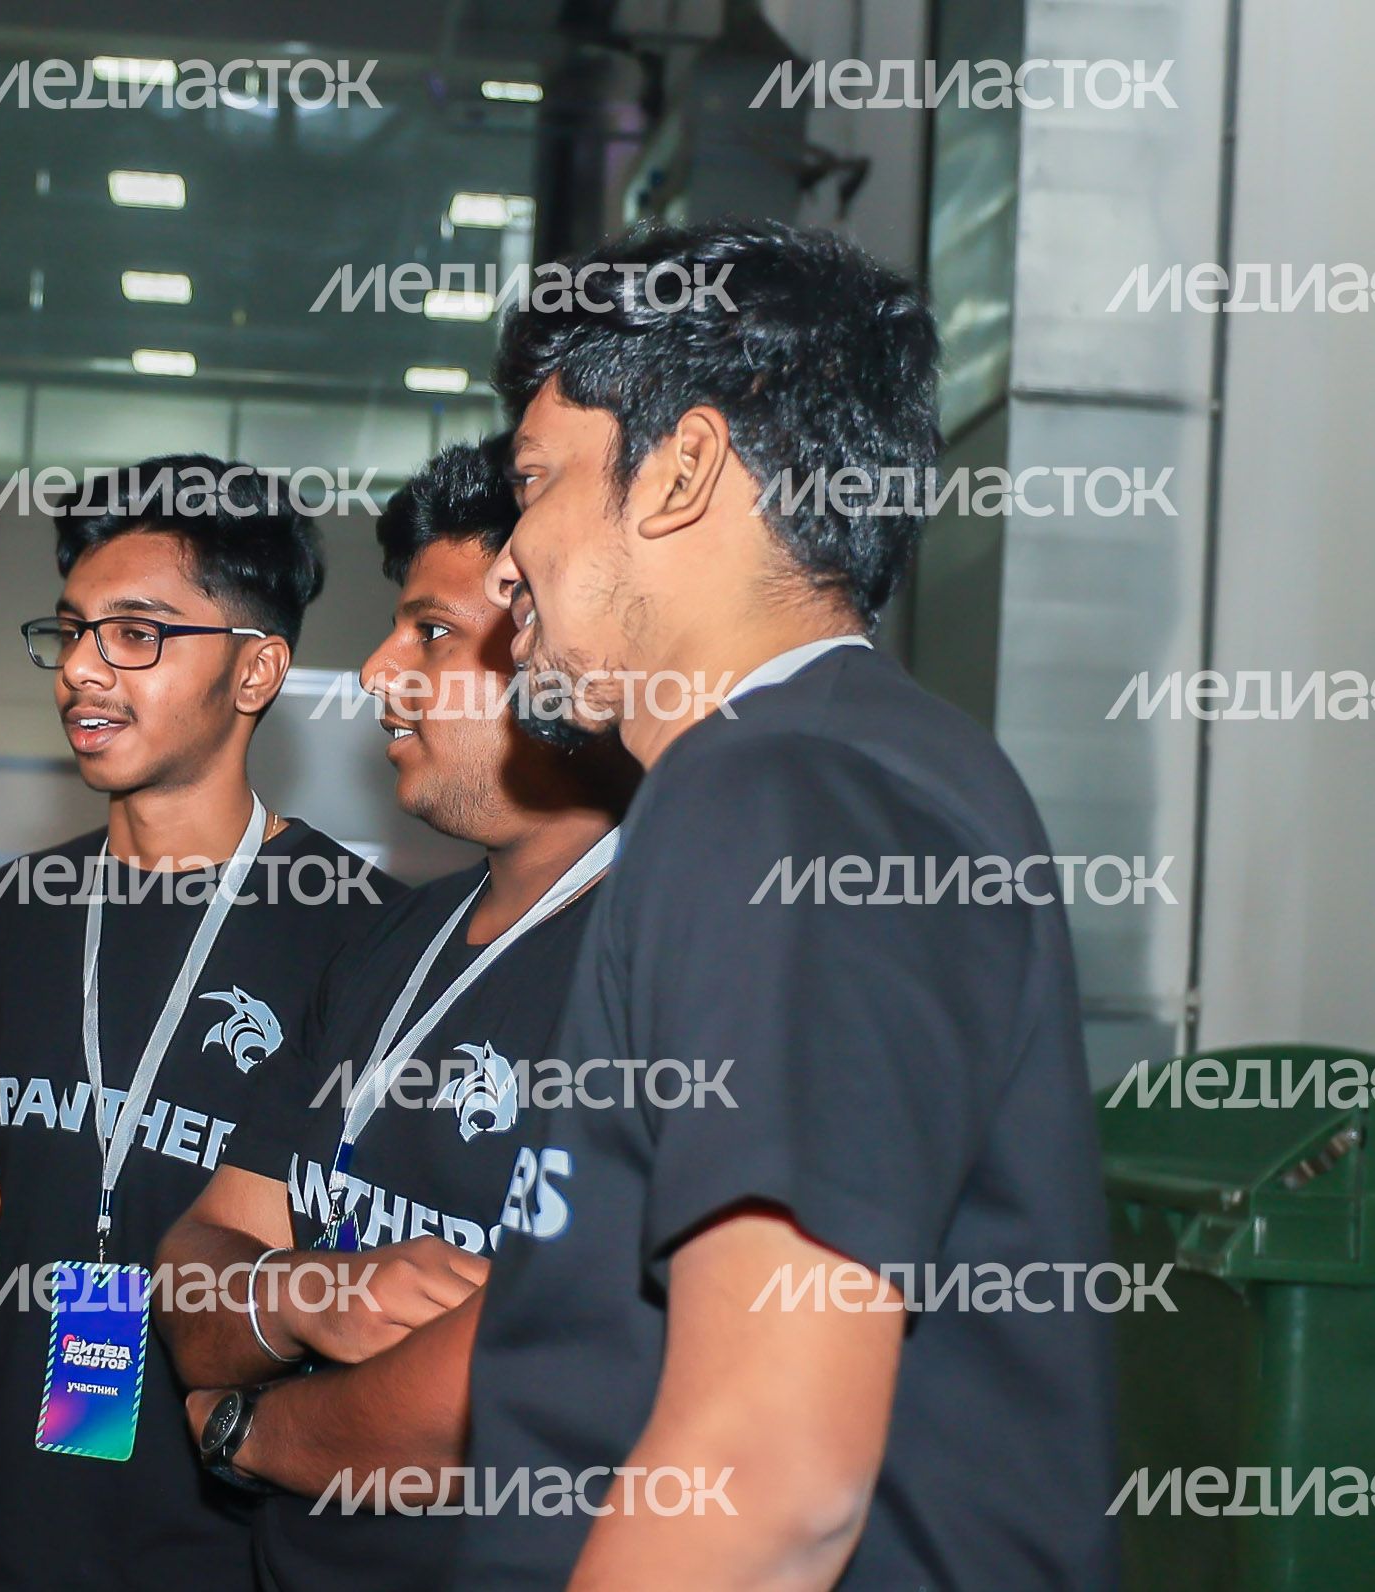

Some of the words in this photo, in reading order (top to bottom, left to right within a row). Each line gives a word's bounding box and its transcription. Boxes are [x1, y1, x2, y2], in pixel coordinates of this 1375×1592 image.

[65, 1339, 131, 1360] БИТВА
[63, 1353, 127, 1370] РОБОТОВ
[66, 1381, 119, 1396] участник
